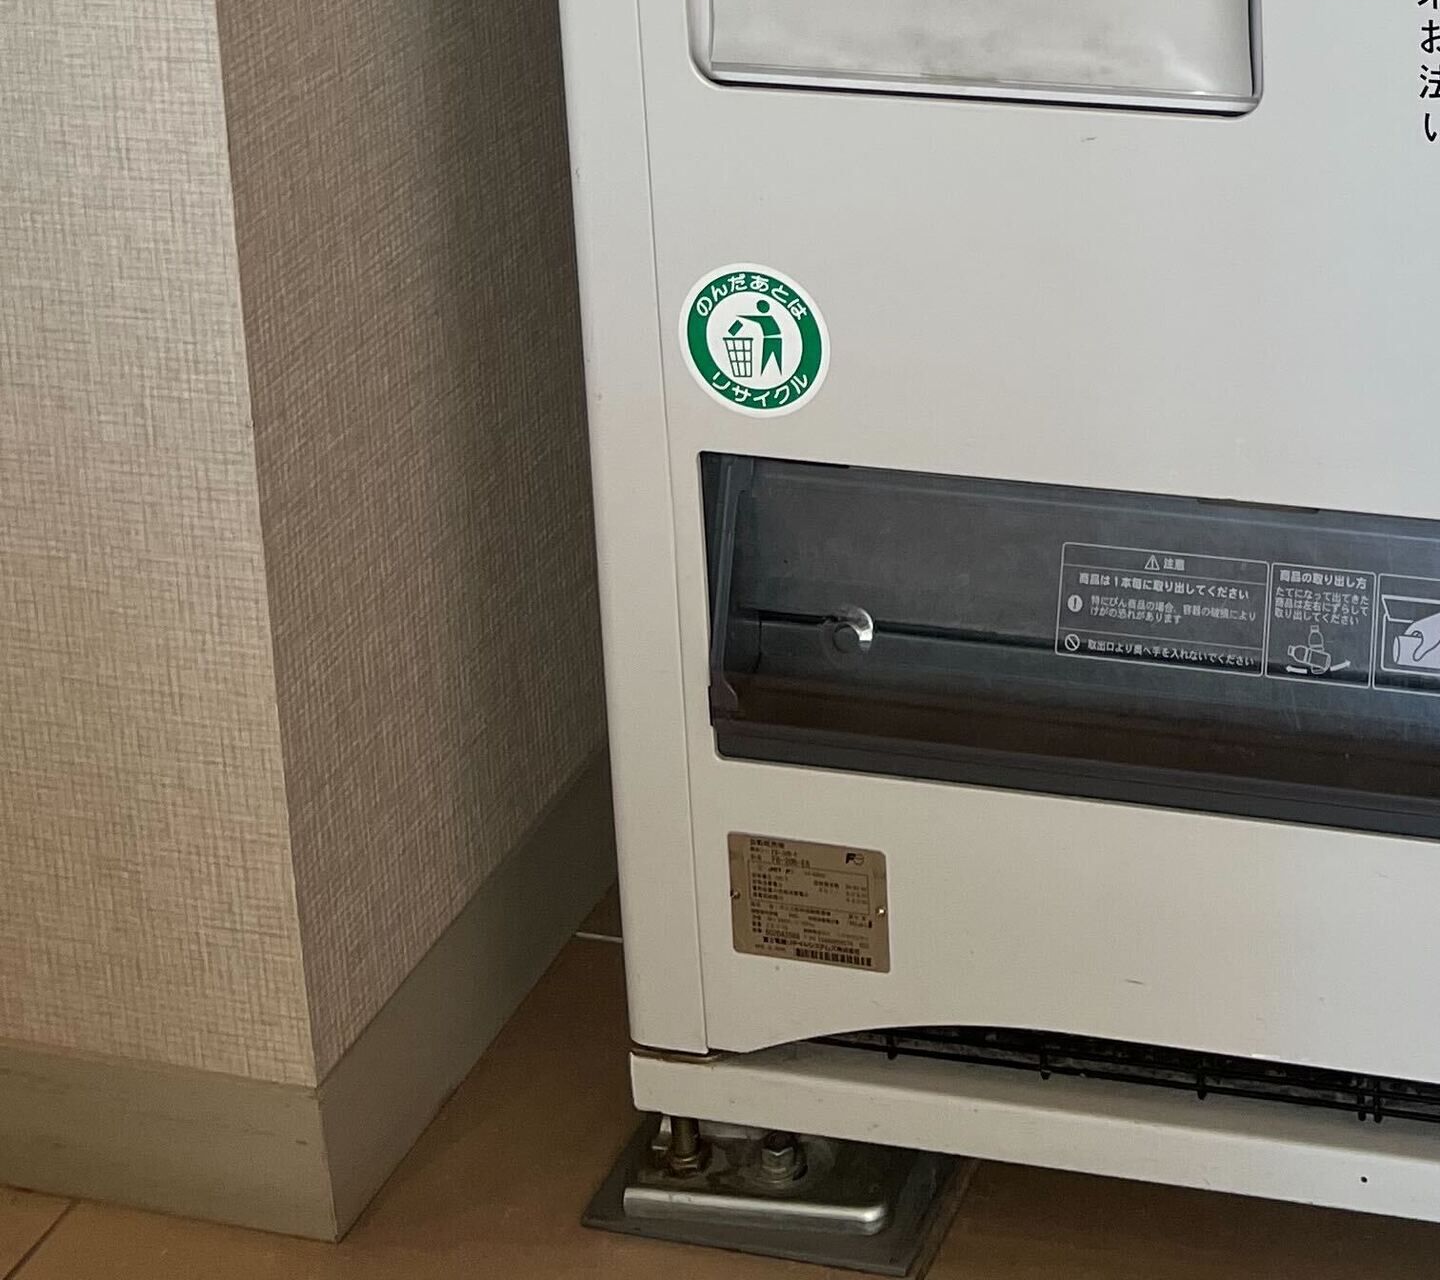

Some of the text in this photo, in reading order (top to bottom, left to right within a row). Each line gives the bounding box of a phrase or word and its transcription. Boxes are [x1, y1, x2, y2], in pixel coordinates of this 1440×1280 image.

[697, 273, 808, 321] のんだあとは
[712, 371, 808, 407] リサイクル
[1163, 557, 1185, 571] 注意
[1280, 570, 1367, 590] 商品の取り出し方
[1276, 586, 1369, 606] たてになって出てきた
[1090, 607, 1182, 625] けがの恐れがあります
[1274, 607, 1359, 625] 取り出してください
[1275, 597, 1369, 616] 商品は左右にずらして
